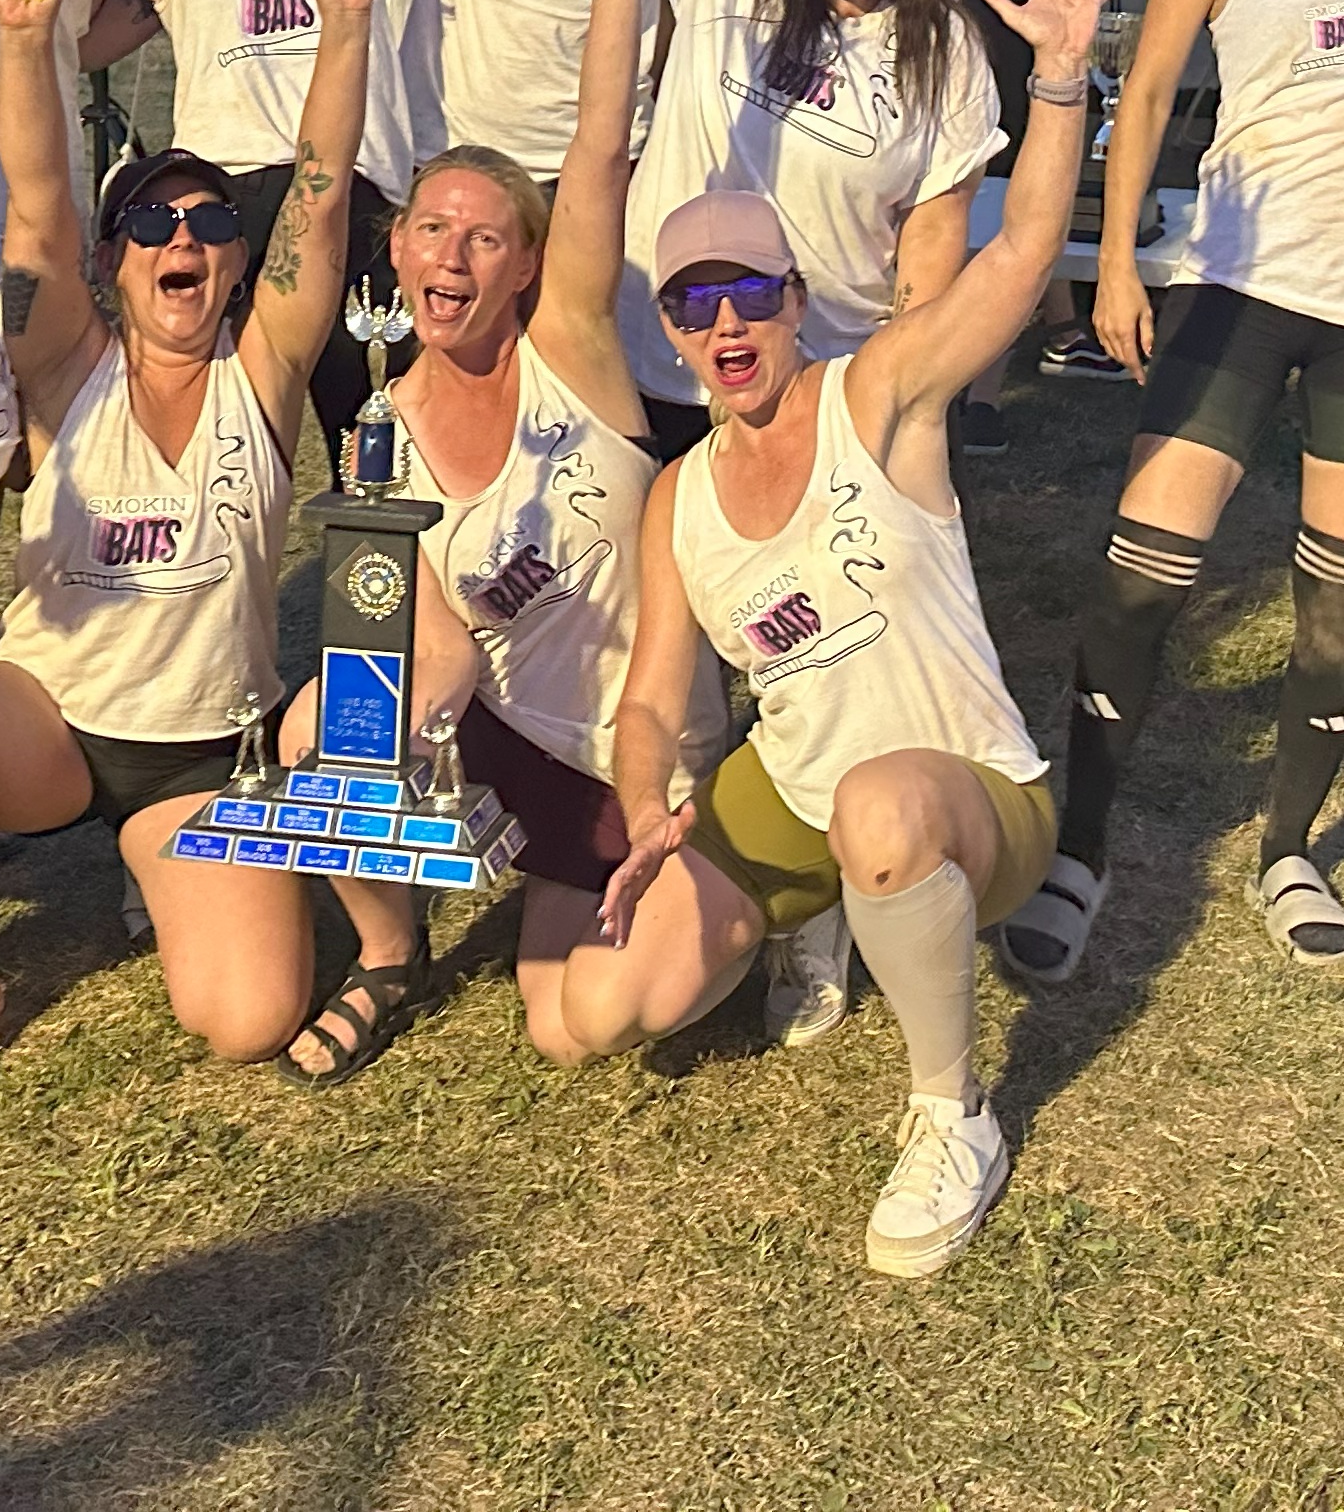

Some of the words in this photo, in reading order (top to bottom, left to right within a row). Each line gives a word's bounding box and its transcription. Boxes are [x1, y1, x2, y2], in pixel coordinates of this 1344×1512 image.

[102, 519, 182, 566] BATS
[478, 543, 556, 620] BATS
[755, 591, 822, 653] BATS
